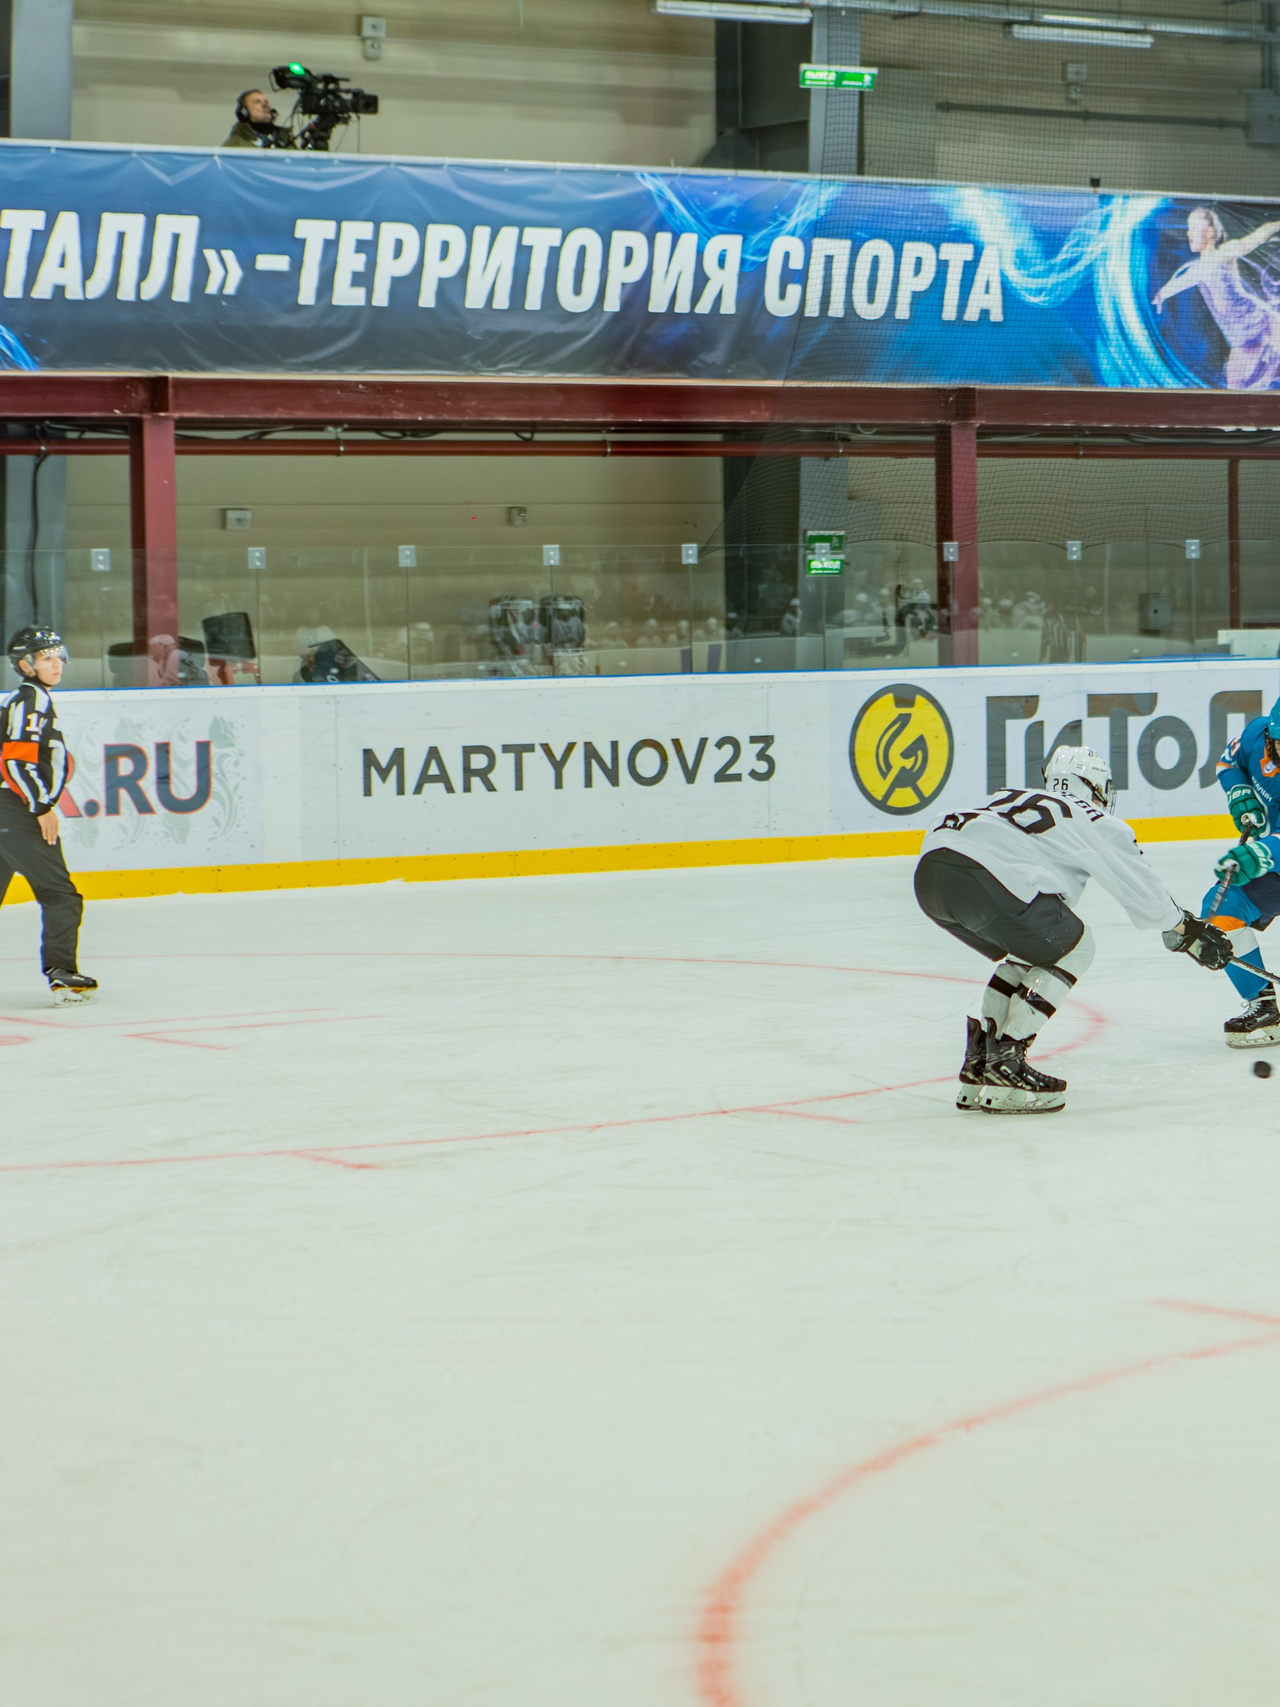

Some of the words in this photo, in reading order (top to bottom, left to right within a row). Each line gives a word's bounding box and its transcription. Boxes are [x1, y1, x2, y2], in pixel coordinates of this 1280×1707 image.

[764, 237, 1004, 323] СПОРТА
[362, 734, 777, 798] MARTYNOV23
[1053, 778, 1069, 792] 26
[1000, 1065, 1032, 1091] CCM
